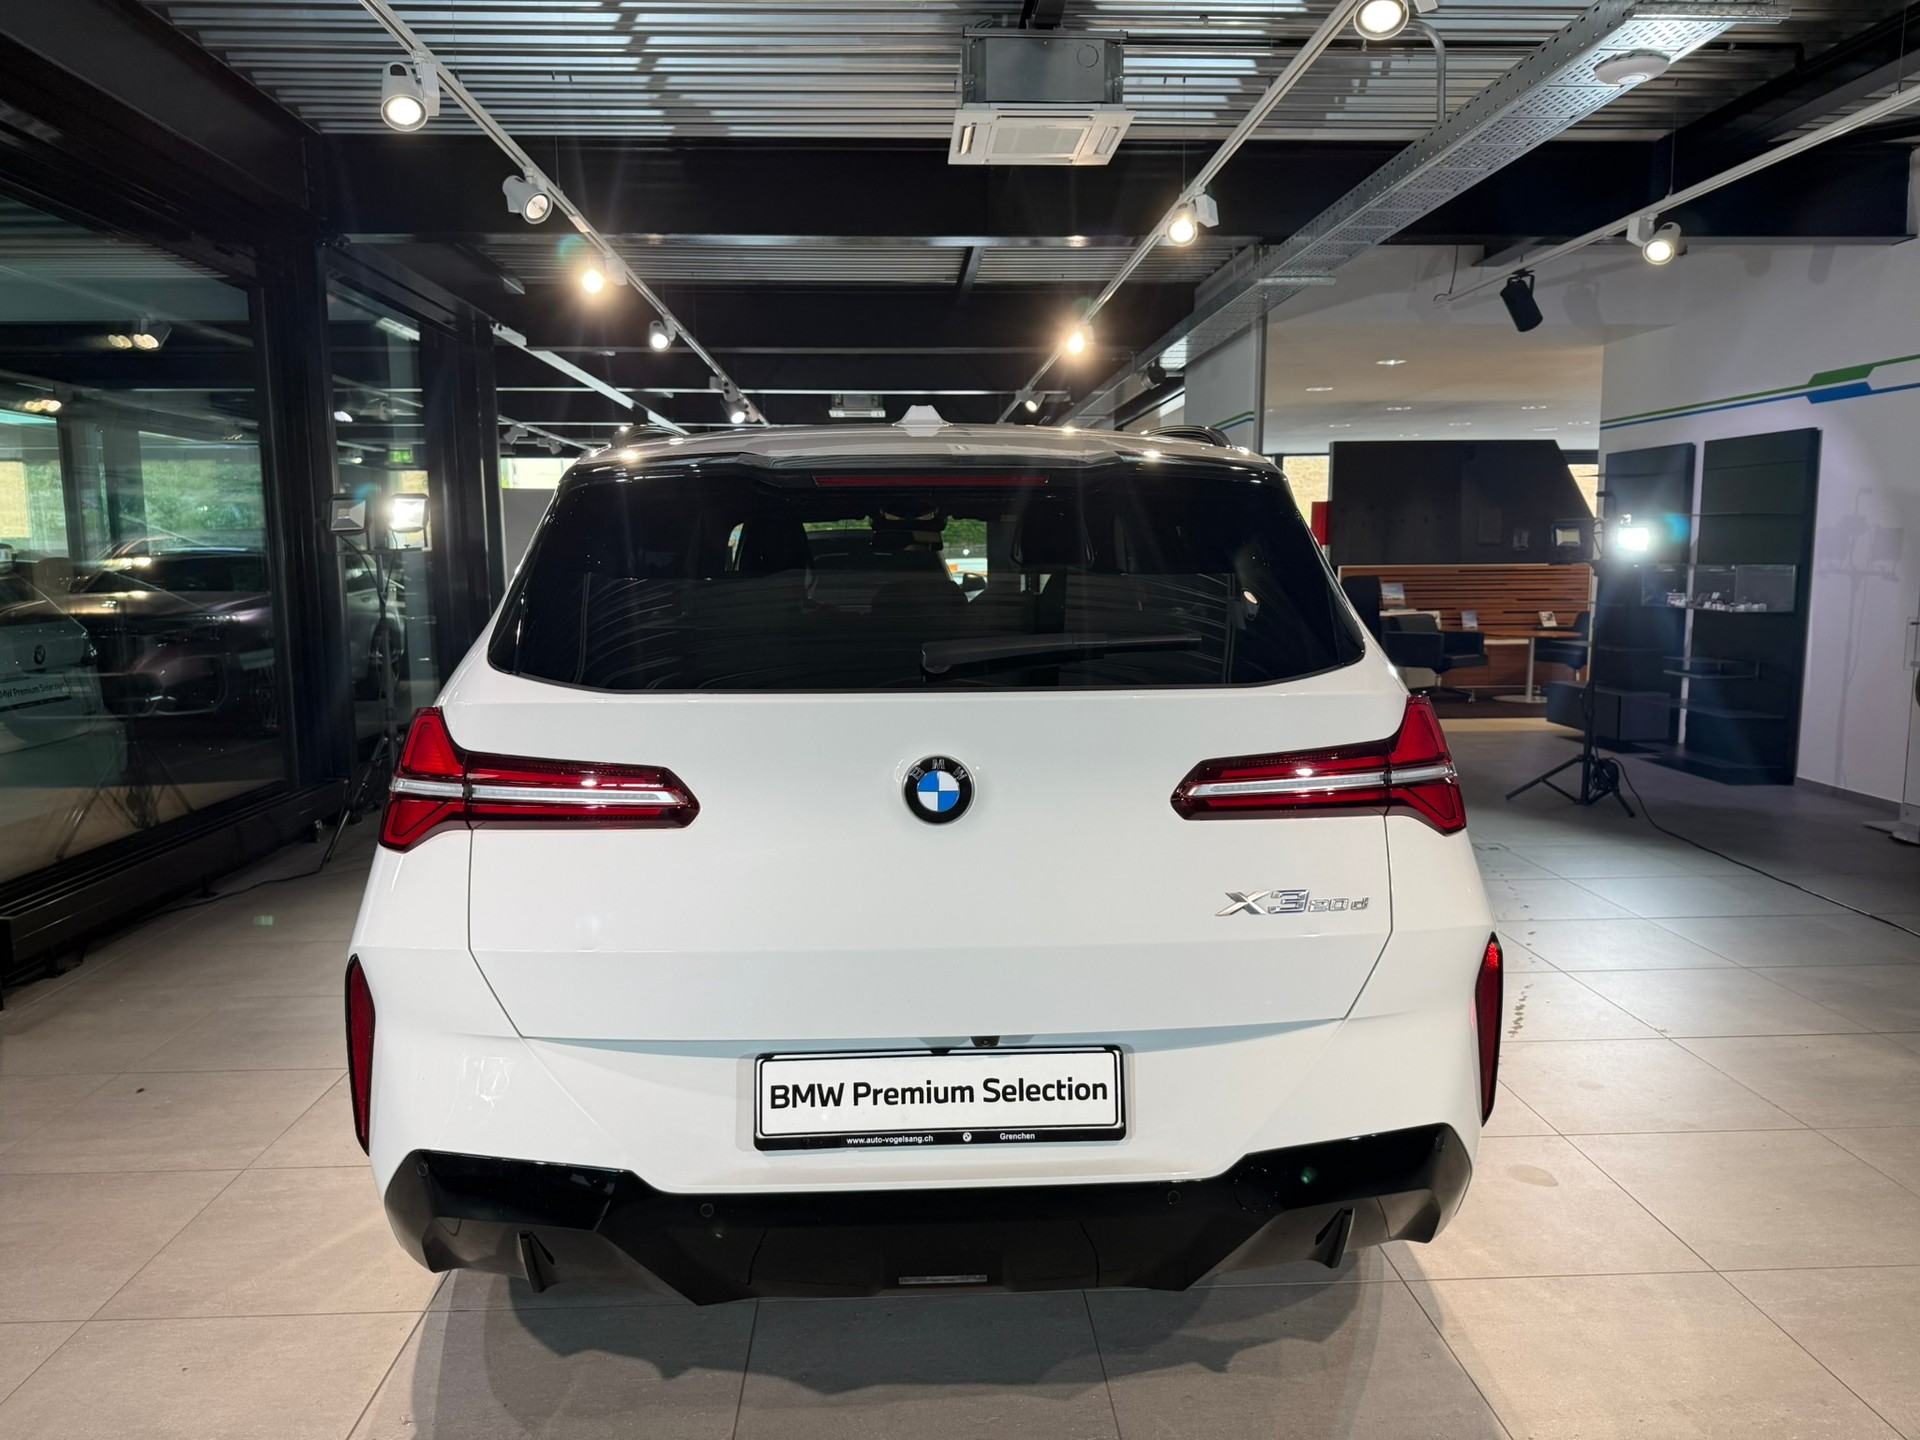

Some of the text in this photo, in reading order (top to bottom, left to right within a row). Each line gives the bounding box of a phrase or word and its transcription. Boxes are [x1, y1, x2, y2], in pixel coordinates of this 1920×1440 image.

[908, 758, 968, 781] BMW
[770, 1076, 1108, 1109] BMW Premium Selection
[846, 1133, 1035, 1145] www.auto-vogelsang.ch Grenchen
